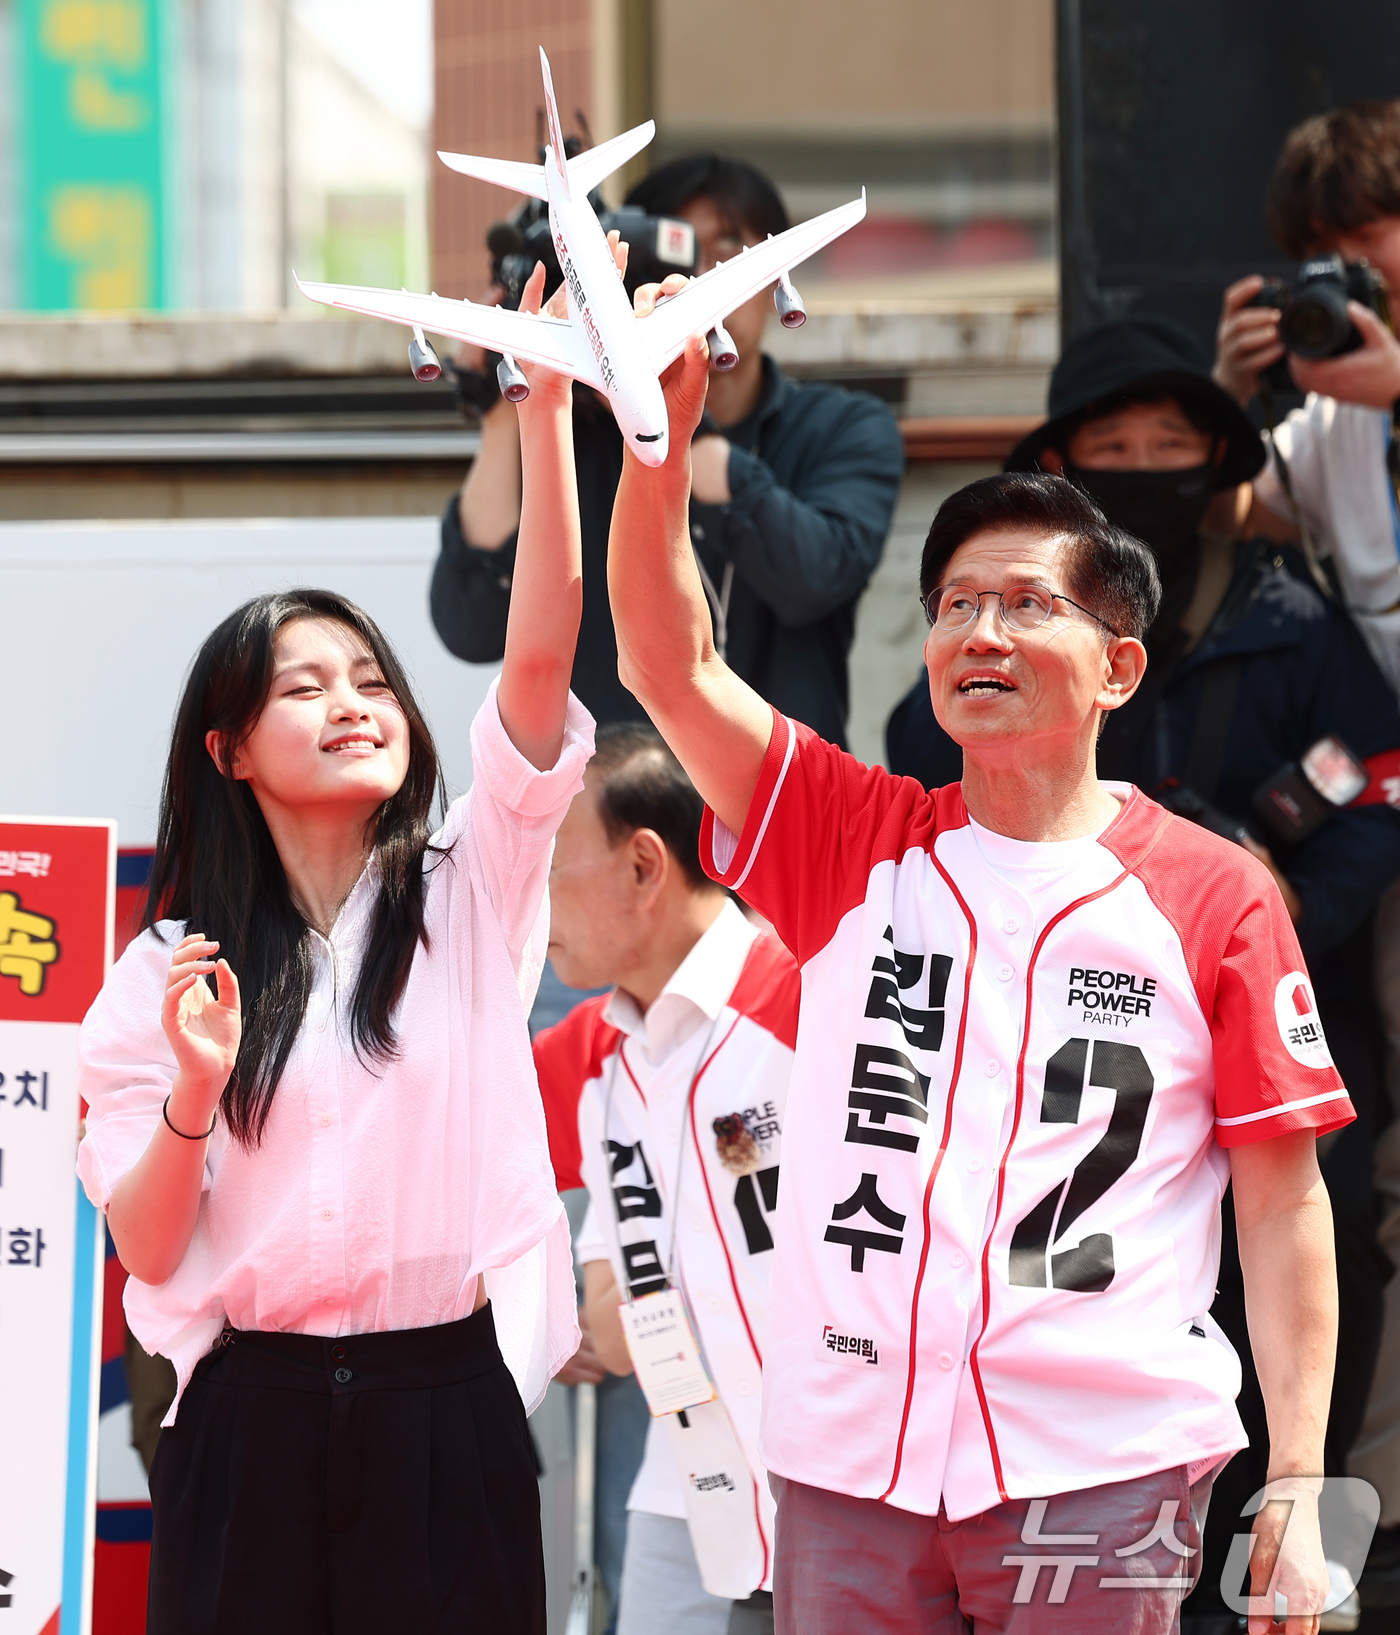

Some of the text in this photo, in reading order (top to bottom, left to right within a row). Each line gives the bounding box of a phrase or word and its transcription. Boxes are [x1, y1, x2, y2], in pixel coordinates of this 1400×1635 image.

[564, 257, 587, 313] 항공물류
[1069, 968, 1157, 997] PEOPLE
[1068, 989, 1151, 1017] POWER
[1083, 1011, 1132, 1027] PARTY
[0, 1070, 48, 1111] 치
[823, 924, 954, 1273] 김문수
[1009, 1038, 1156, 1293] 2
[0, 1227, 46, 1267] 화
